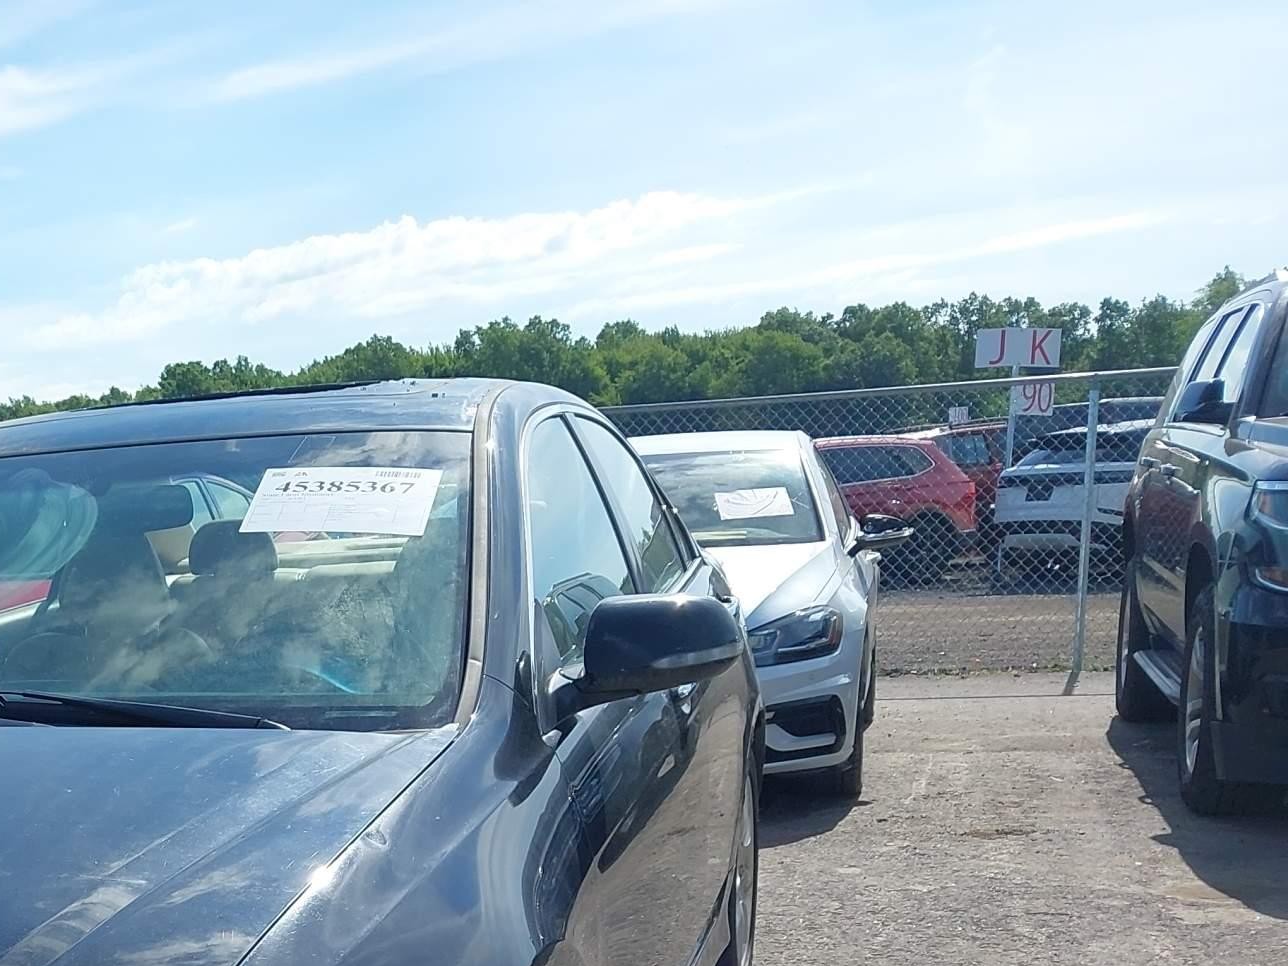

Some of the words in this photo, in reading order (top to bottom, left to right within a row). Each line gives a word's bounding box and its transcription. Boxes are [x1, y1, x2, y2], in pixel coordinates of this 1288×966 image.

[989, 330, 1007, 364] J
[1031, 330, 1052, 364] K
[1022, 383, 1053, 414] 90
[275, 481, 415, 494] 45385367
